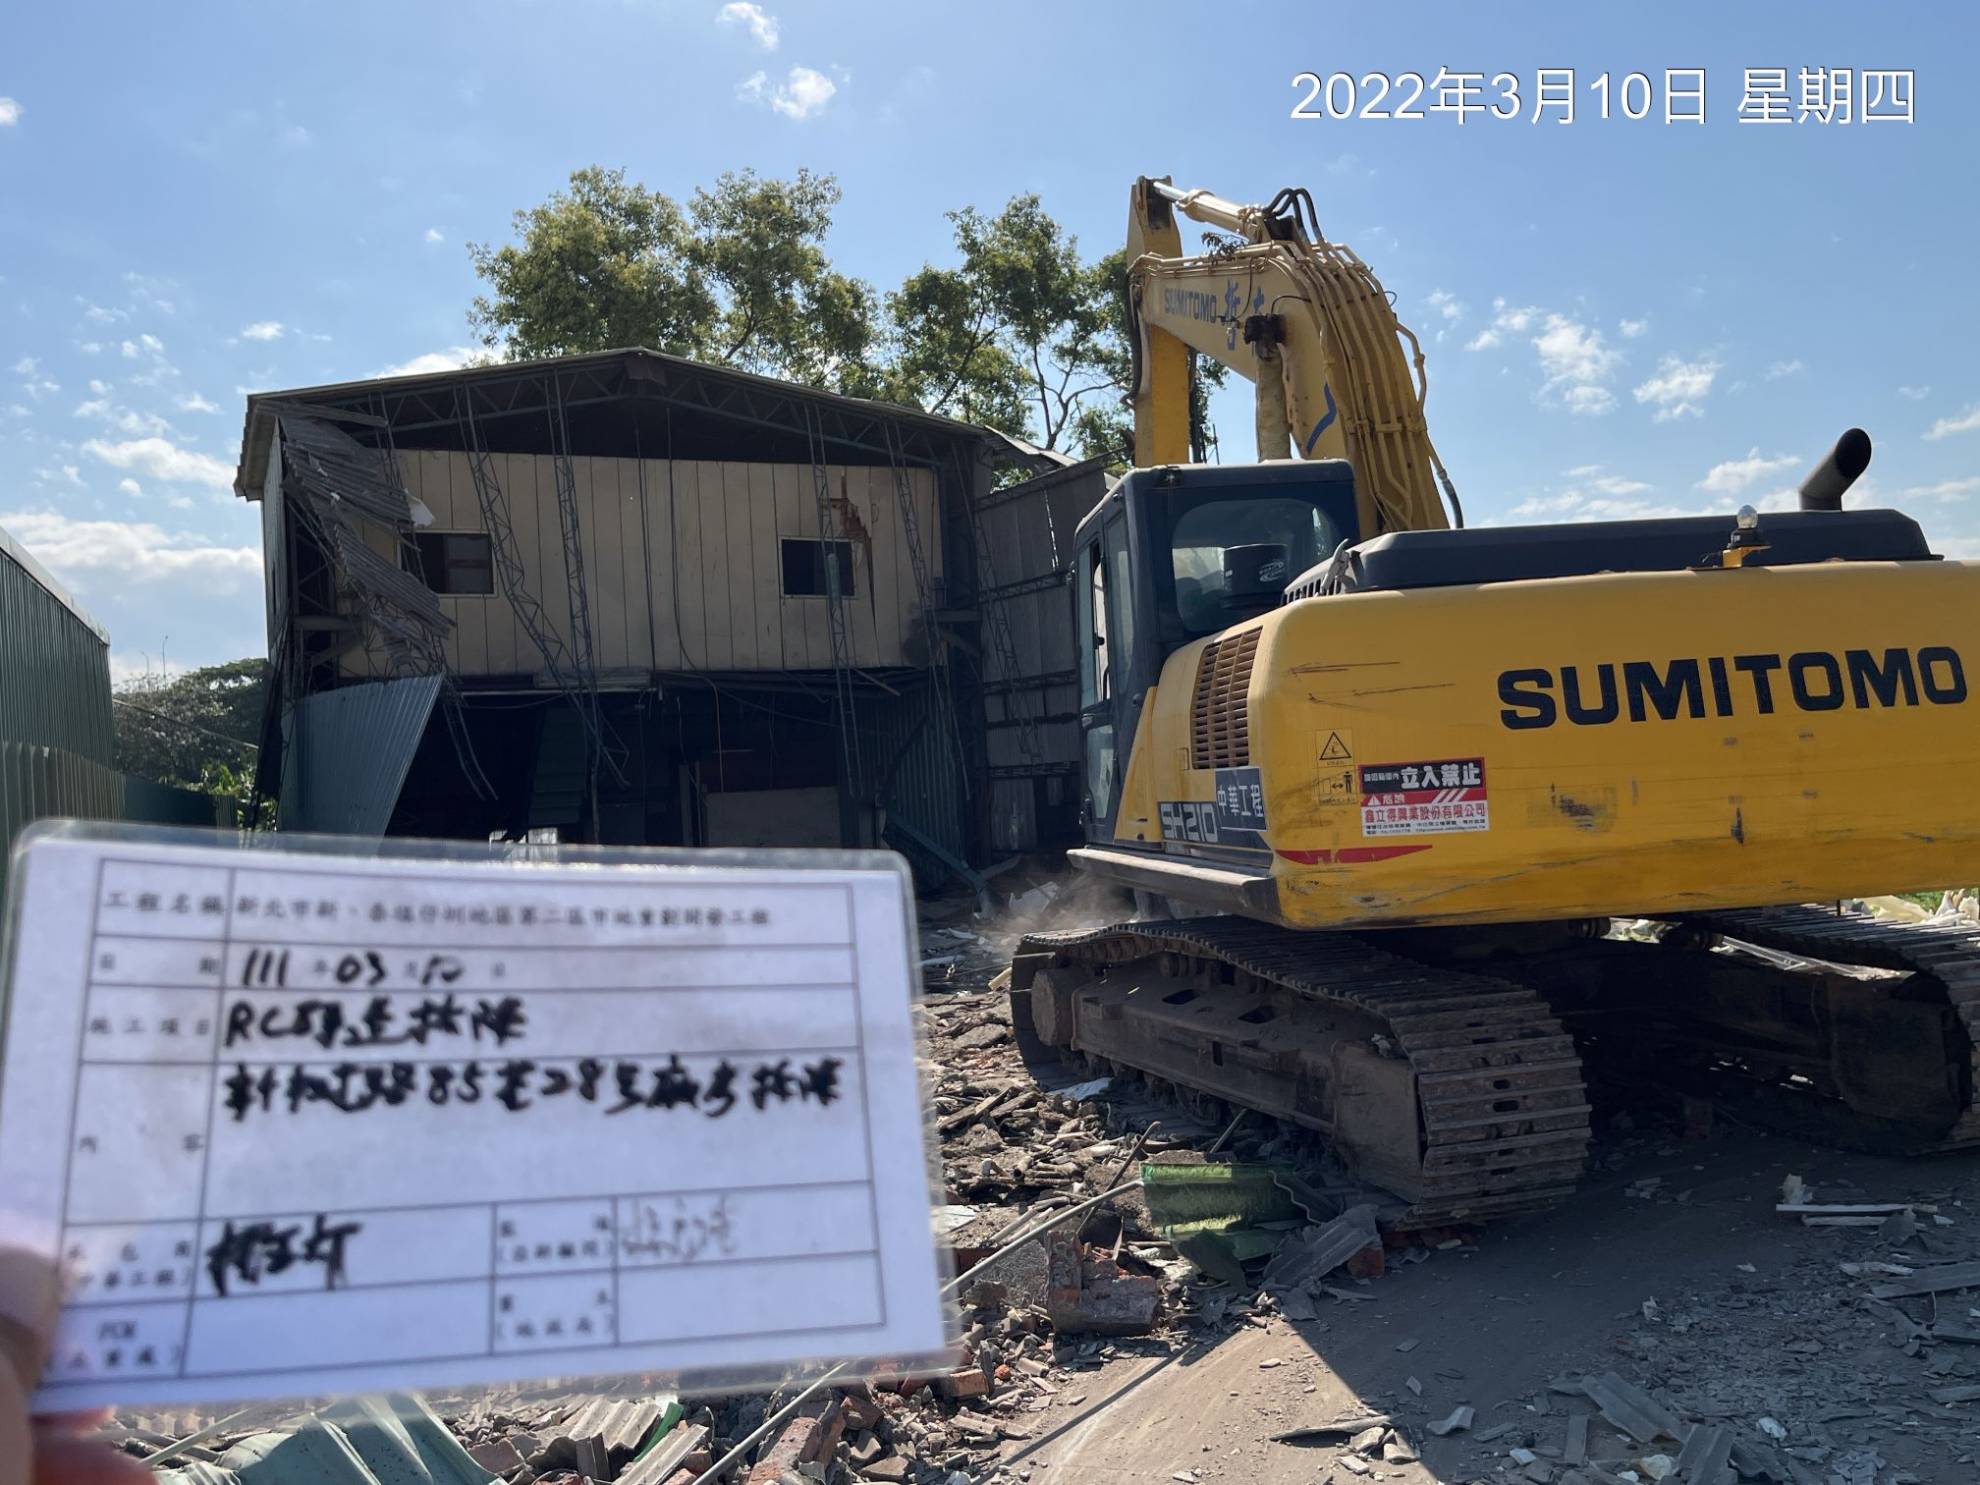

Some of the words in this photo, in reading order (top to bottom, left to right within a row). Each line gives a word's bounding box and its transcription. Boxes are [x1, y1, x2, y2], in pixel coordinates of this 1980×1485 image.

[1164, 287, 1217, 324] SUMITOMO
[1497, 646, 1968, 730] SUMITOMO
[1401, 762, 1481, 789] 立入禁止
[1217, 784, 1265, 818] 中華工程
[1160, 802, 1219, 842] SH210
